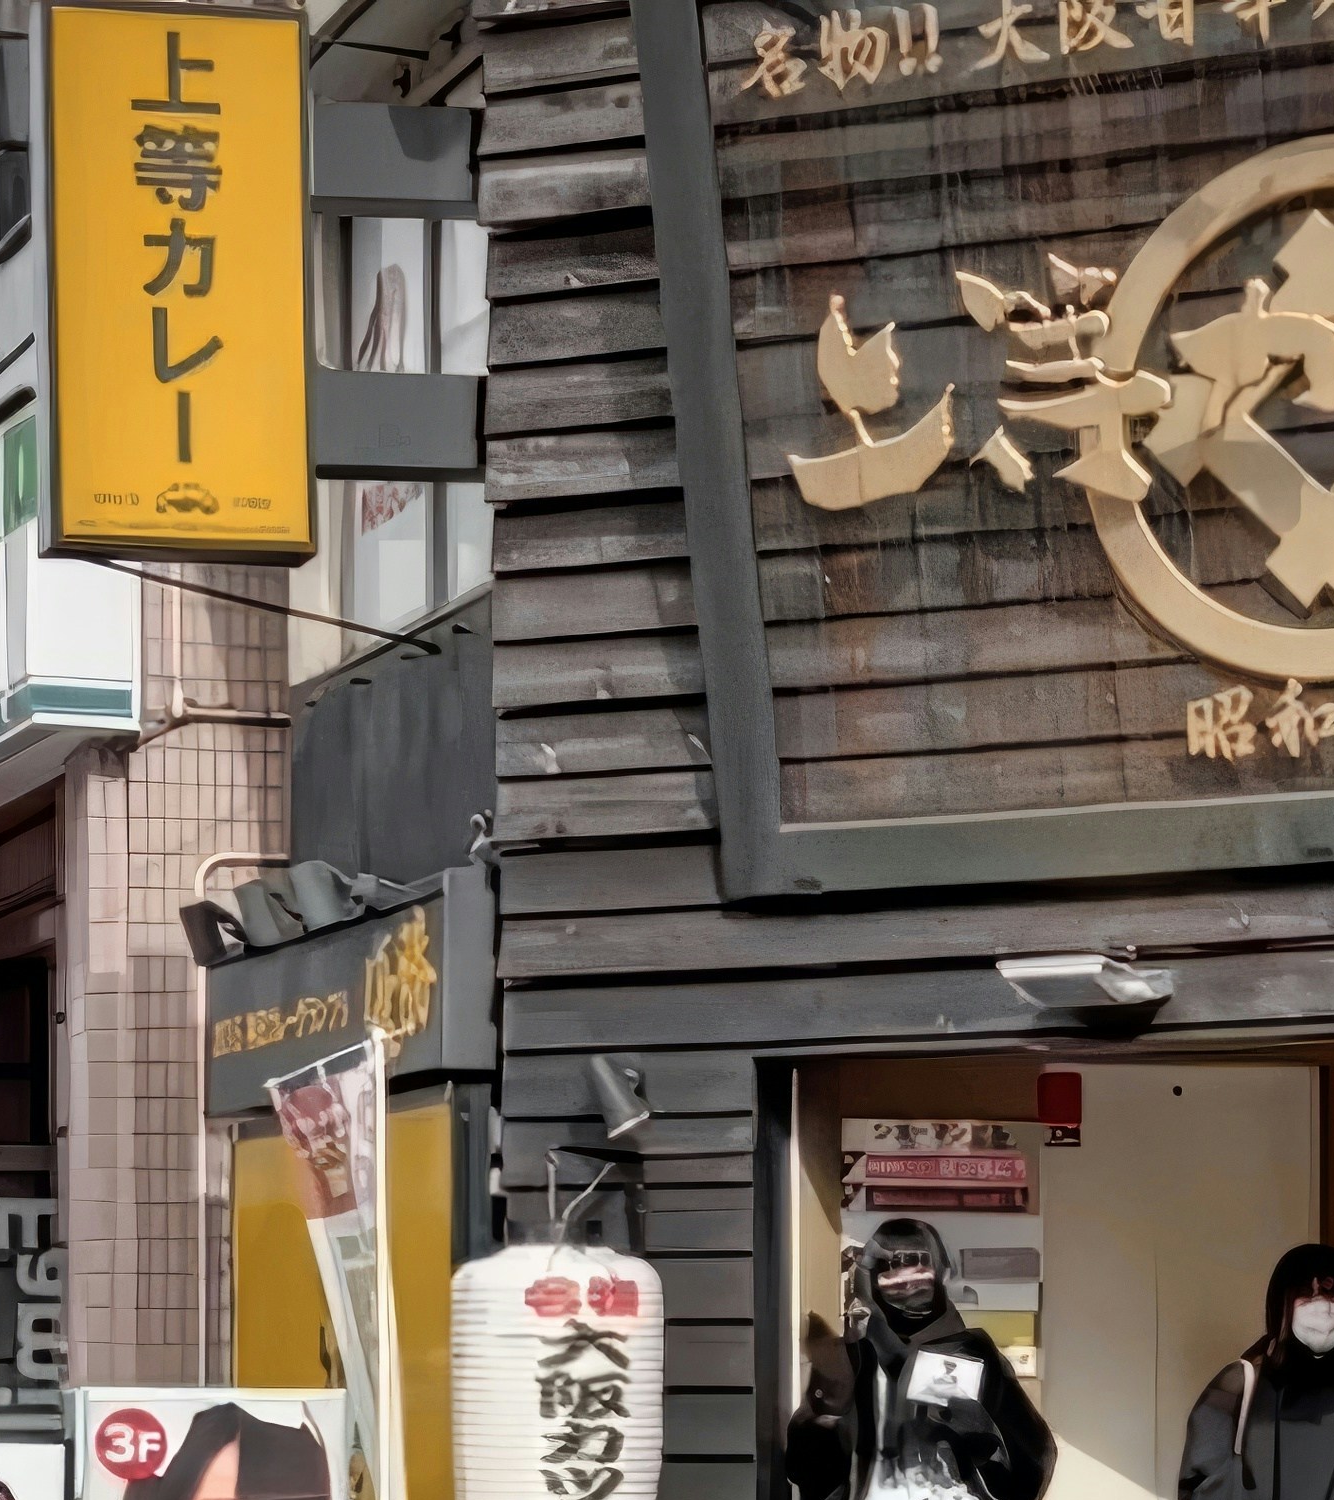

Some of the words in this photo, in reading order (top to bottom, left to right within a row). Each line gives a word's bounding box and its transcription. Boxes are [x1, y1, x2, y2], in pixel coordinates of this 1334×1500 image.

[130, 30, 224, 464] 上等カレー
[102, 1423, 161, 1464] 3F
